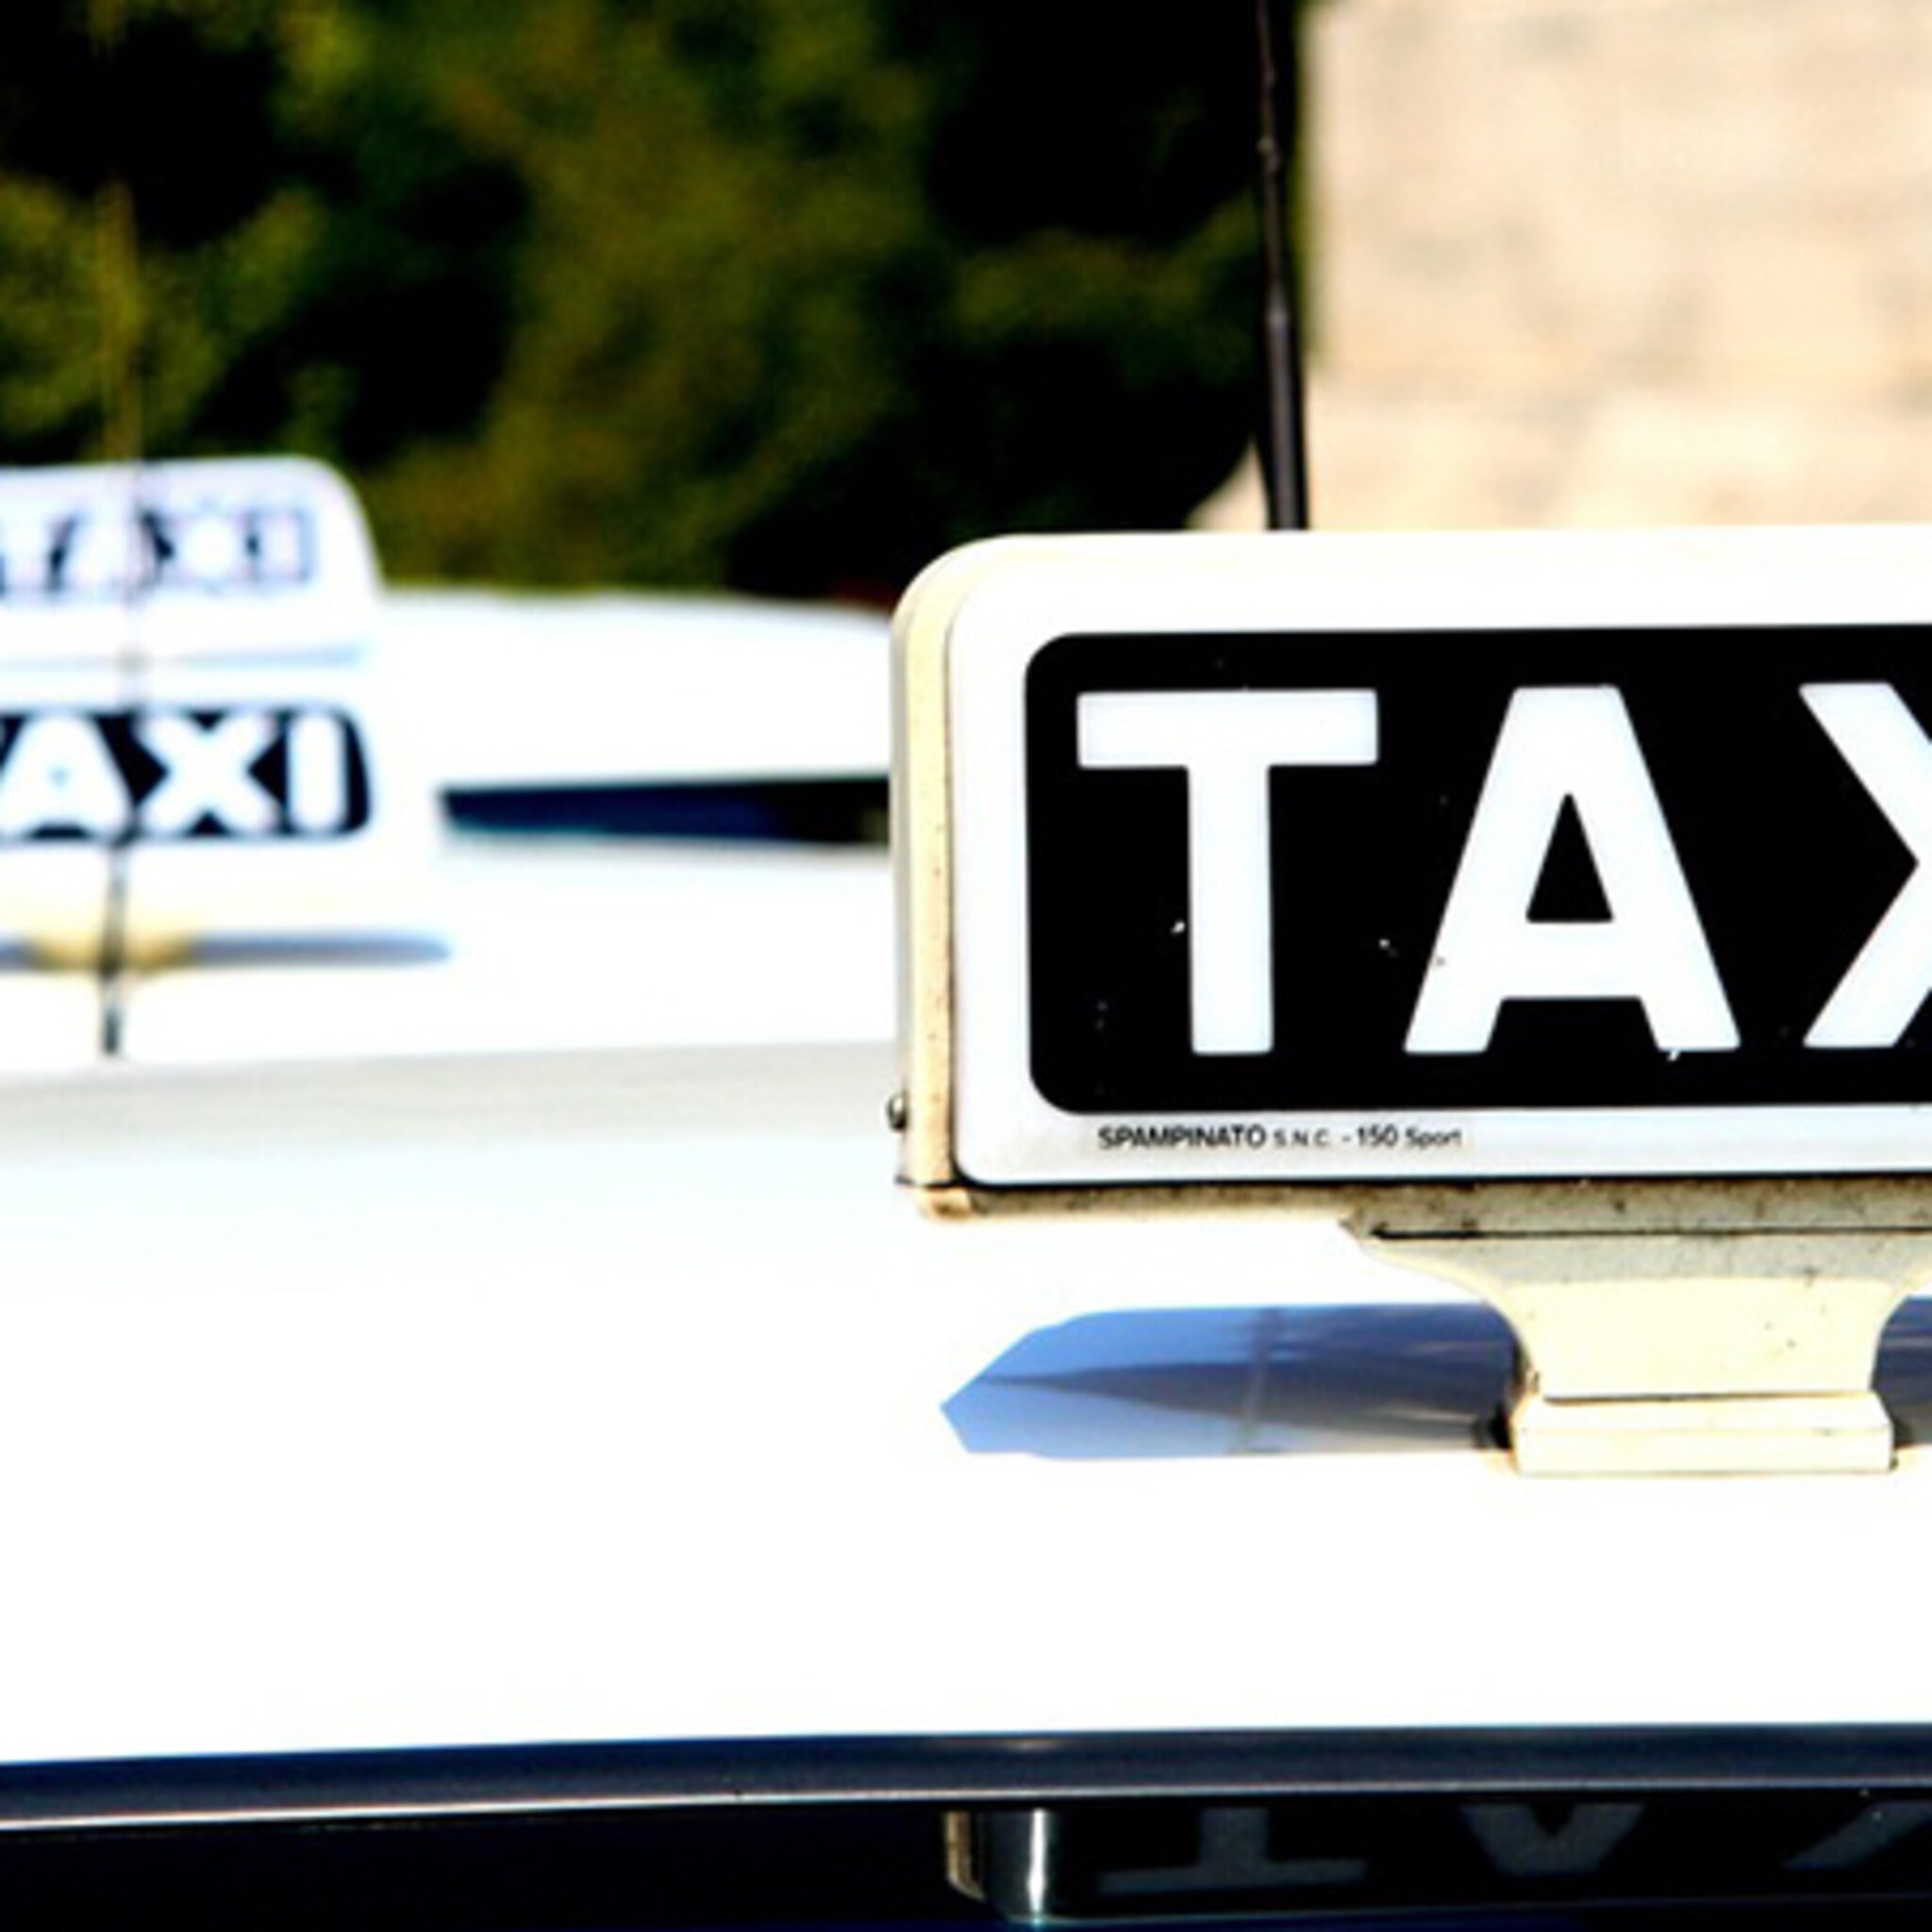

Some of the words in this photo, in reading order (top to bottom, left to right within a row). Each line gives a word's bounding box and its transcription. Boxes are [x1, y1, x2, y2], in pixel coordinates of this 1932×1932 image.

[1097, 1124, 1266, 1149] SPAMPINATO
[1357, 1124, 1398, 1147] 150
[1406, 1127, 1461, 1150] Sport
